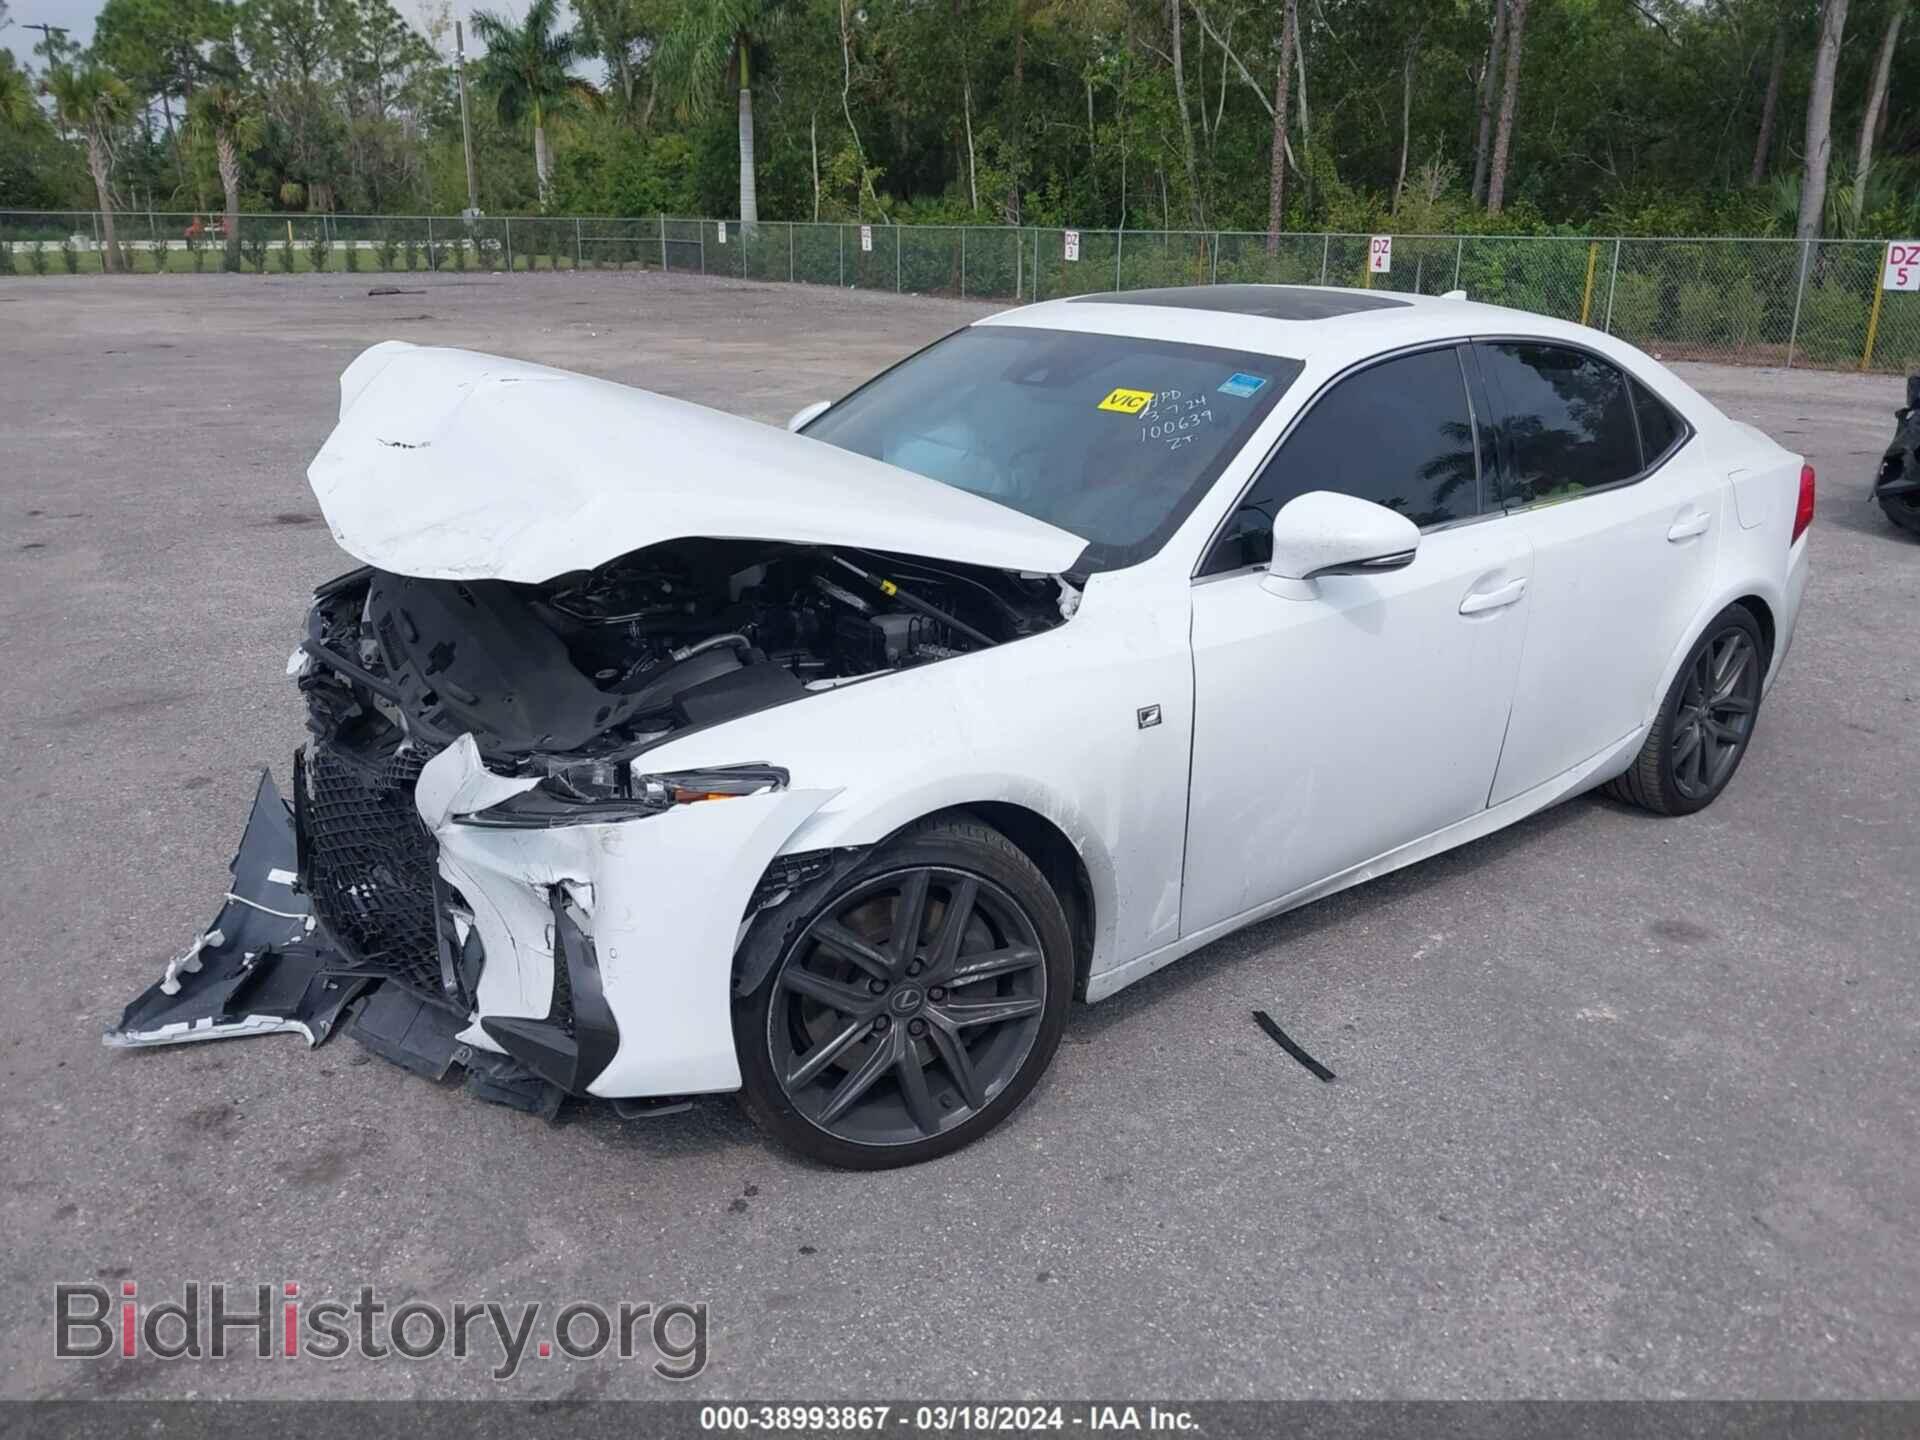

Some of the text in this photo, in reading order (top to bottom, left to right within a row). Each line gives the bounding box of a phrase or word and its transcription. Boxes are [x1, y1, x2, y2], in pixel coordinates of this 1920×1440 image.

[1373, 240, 1389, 254] DZ
[1375, 256, 1382, 269] 4
[1890, 246, 1920, 265] DZ
[1896, 268, 1908, 286] 5
[1110, 394, 1145, 408] VIC
[1142, 409, 1212, 442] 100639
